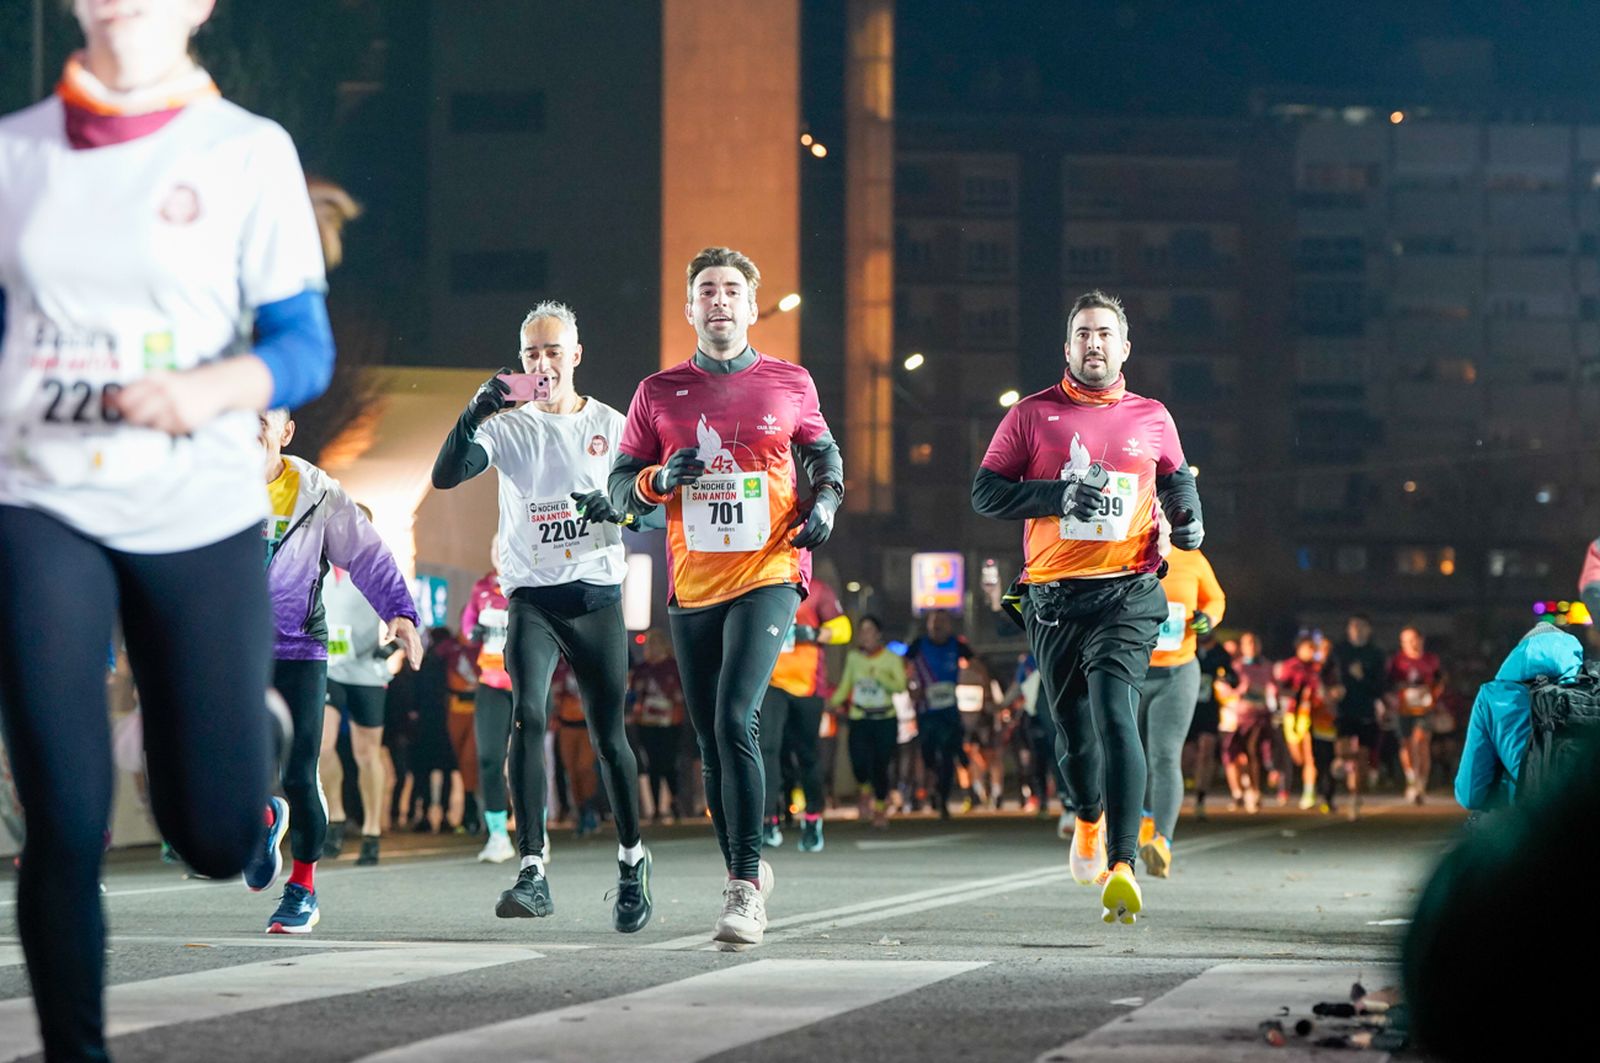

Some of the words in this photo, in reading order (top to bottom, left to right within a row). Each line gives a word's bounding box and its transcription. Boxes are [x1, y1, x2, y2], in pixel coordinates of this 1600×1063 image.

[701, 482, 725, 491] NOCHE
[726, 482, 736, 490] DE
[692, 492, 708, 501] SAN
[538, 504, 559, 513] NOCHE
[1098, 496, 1123, 517] 99
[708, 501, 743, 525] 701
[531, 514, 545, 523] SAN
[539, 517, 589, 543] 2202
